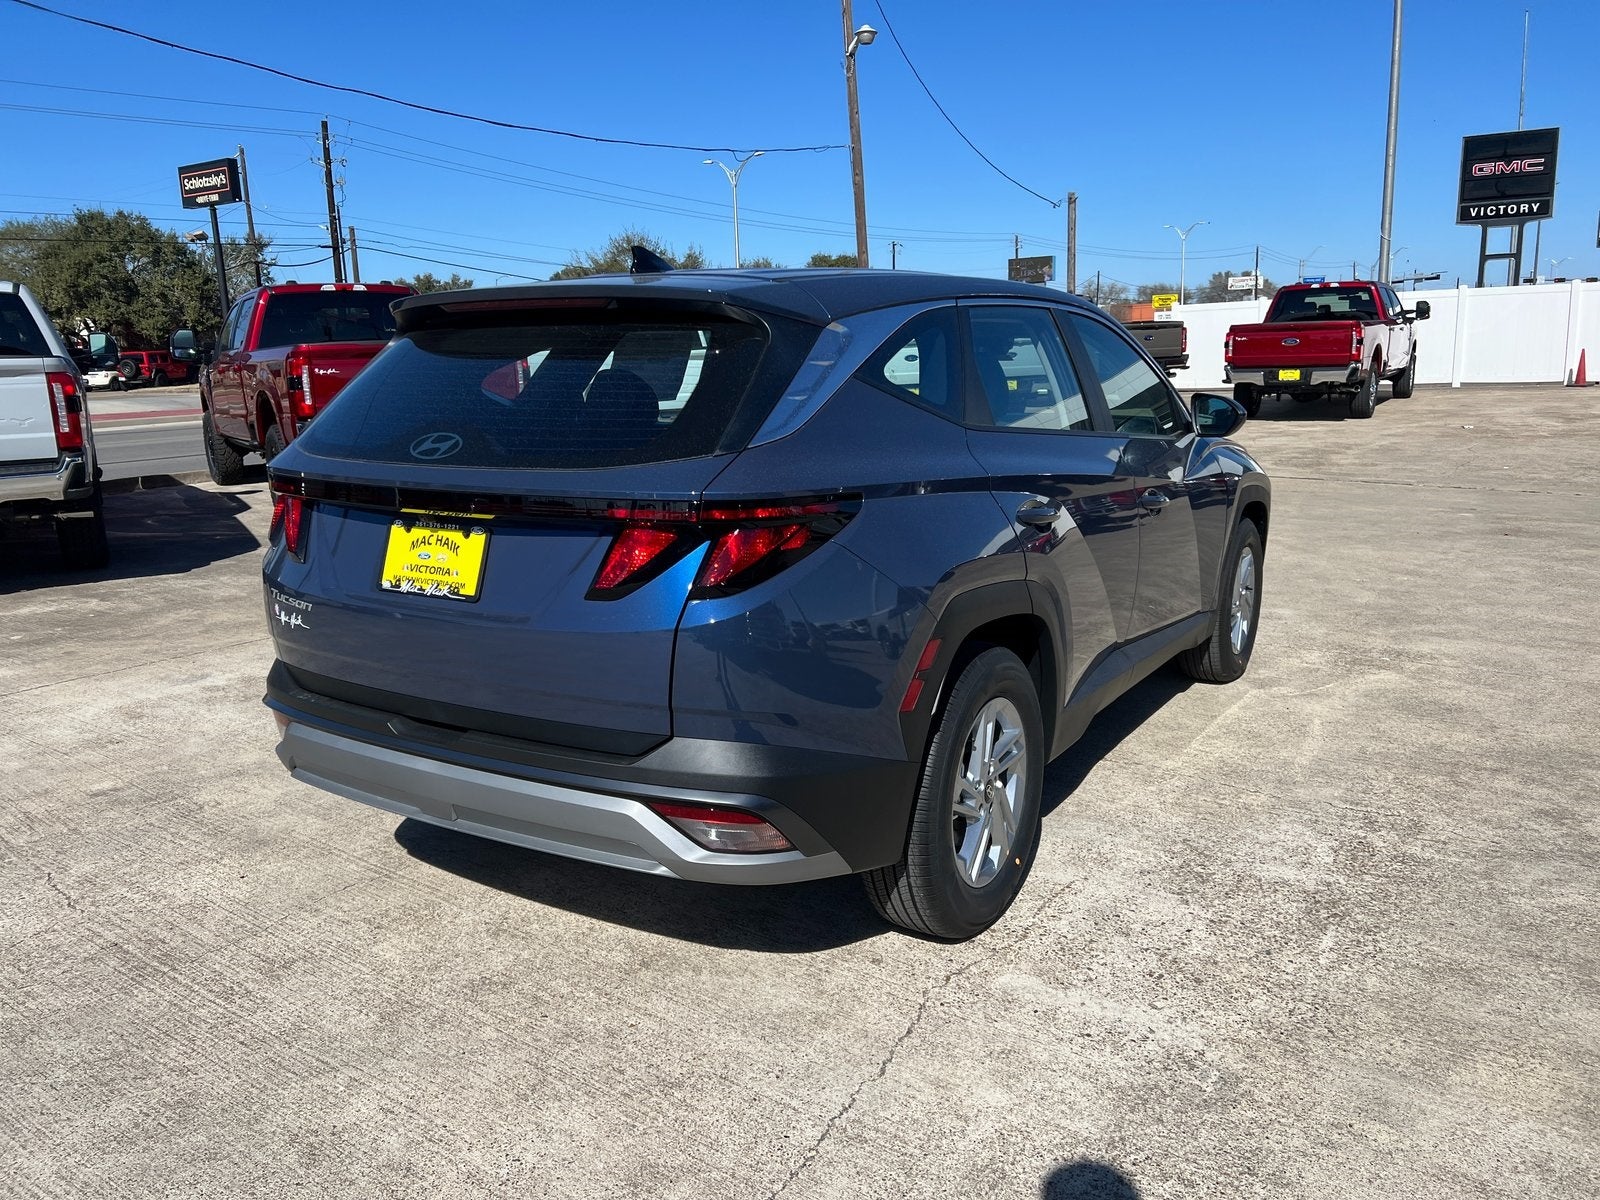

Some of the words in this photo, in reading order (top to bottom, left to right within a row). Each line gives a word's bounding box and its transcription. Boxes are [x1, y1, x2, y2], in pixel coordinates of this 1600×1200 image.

[1472, 158, 1545, 177] GMC
[183, 173, 226, 190] Schlotzsky's
[1469, 202, 1540, 217] VICTORY
[409, 534, 434, 552] MAC
[435, 534, 460, 557] HAIK
[409, 563, 451, 577] VICTORIA
